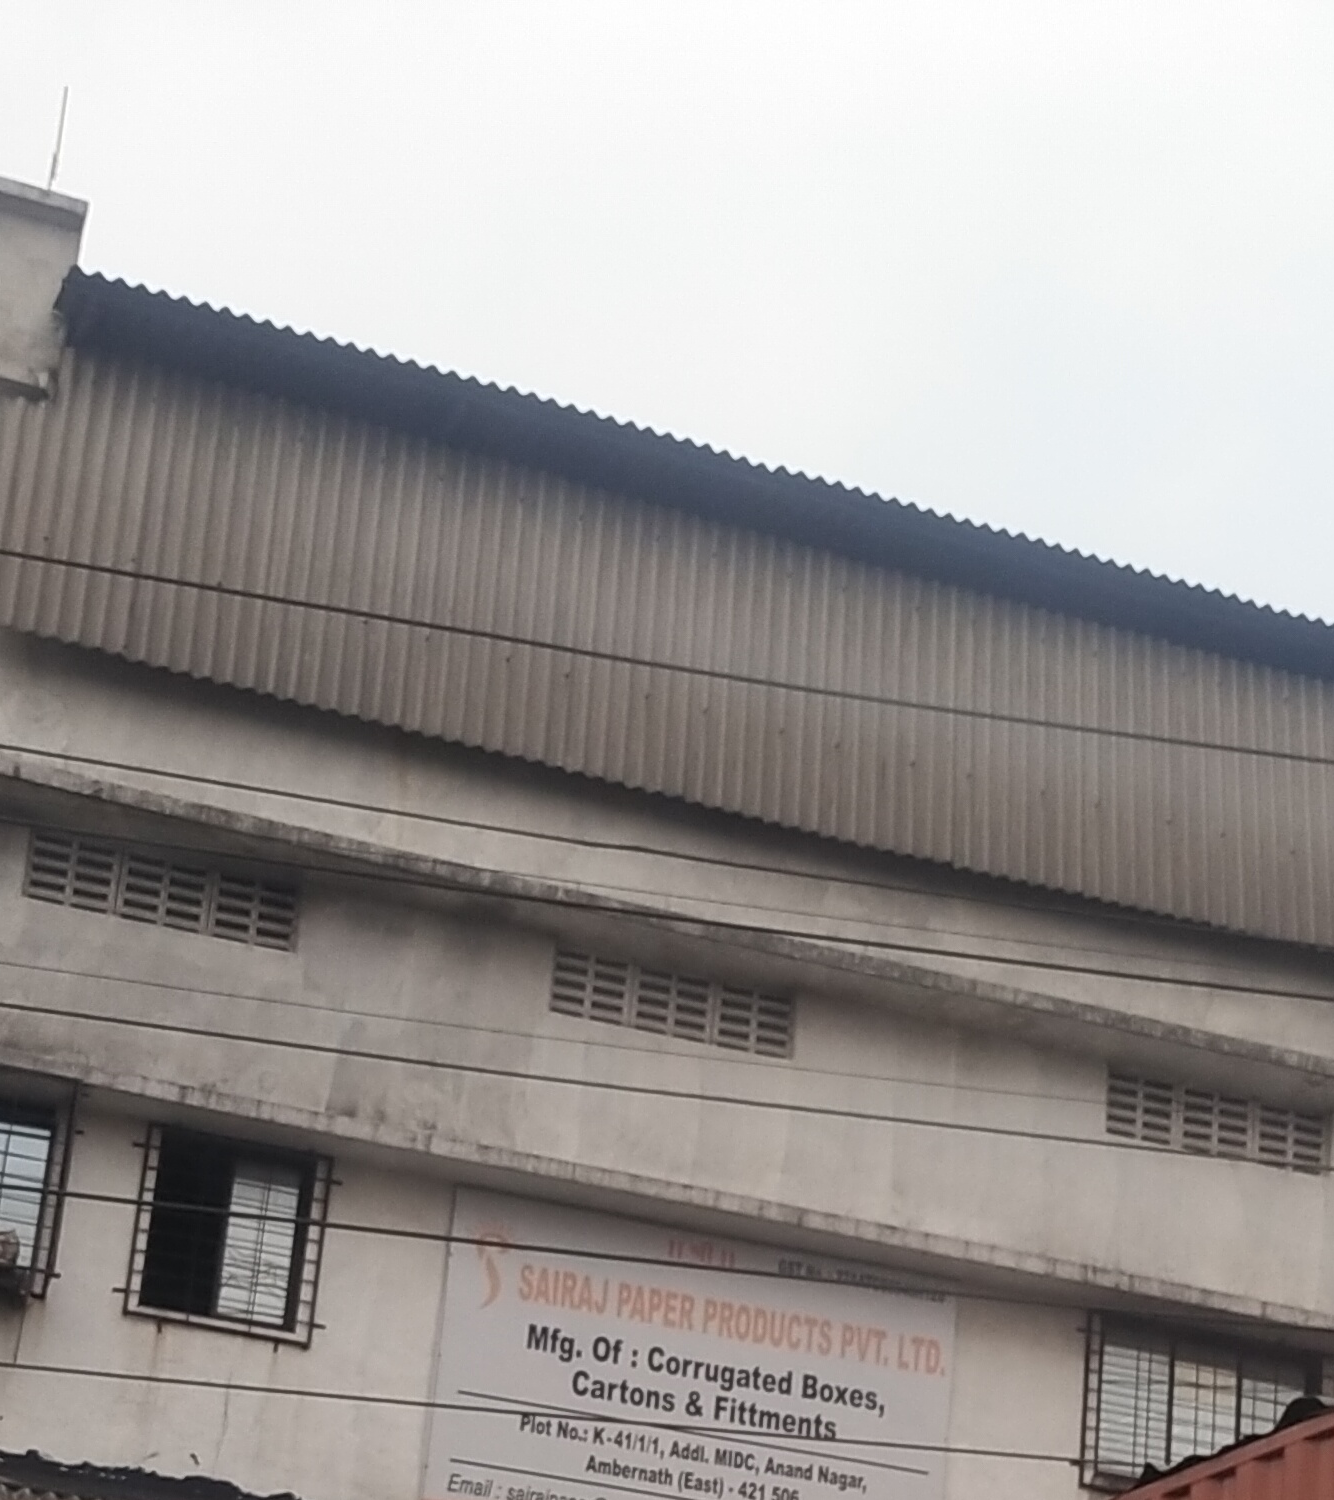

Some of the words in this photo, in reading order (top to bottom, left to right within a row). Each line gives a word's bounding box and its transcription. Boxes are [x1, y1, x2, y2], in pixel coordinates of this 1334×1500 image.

[519, 1264, 609, 1315] SAIRAJ
[616, 1280, 695, 1331] PAPER
[702, 1297, 833, 1356] PRODUCTS
[839, 1322, 888, 1367] PVT.
[896, 1332, 946, 1376] LTD.
[527, 1323, 583, 1363] Mfg.
[592, 1336, 623, 1364] Of
[648, 1346, 793, 1395] Corrugated
[801, 1373, 885, 1418] Boxes,
[572, 1370, 676, 1413] Cartons
[684, 1391, 703, 1418] &
[714, 1395, 838, 1440] Fittments
[446, 1473, 494, 1498] Email
[519, 1413, 552, 1436] Plot
[669, 1440, 709, 1464] Addl.
[714, 1447, 760, 1476] MIDC,
[764, 1457, 814, 1482] Anand
[817, 1465, 868, 1495] Nagar,
[585, 1455, 673, 1486] Ambernath
[677, 1470, 724, 1500] (East)
